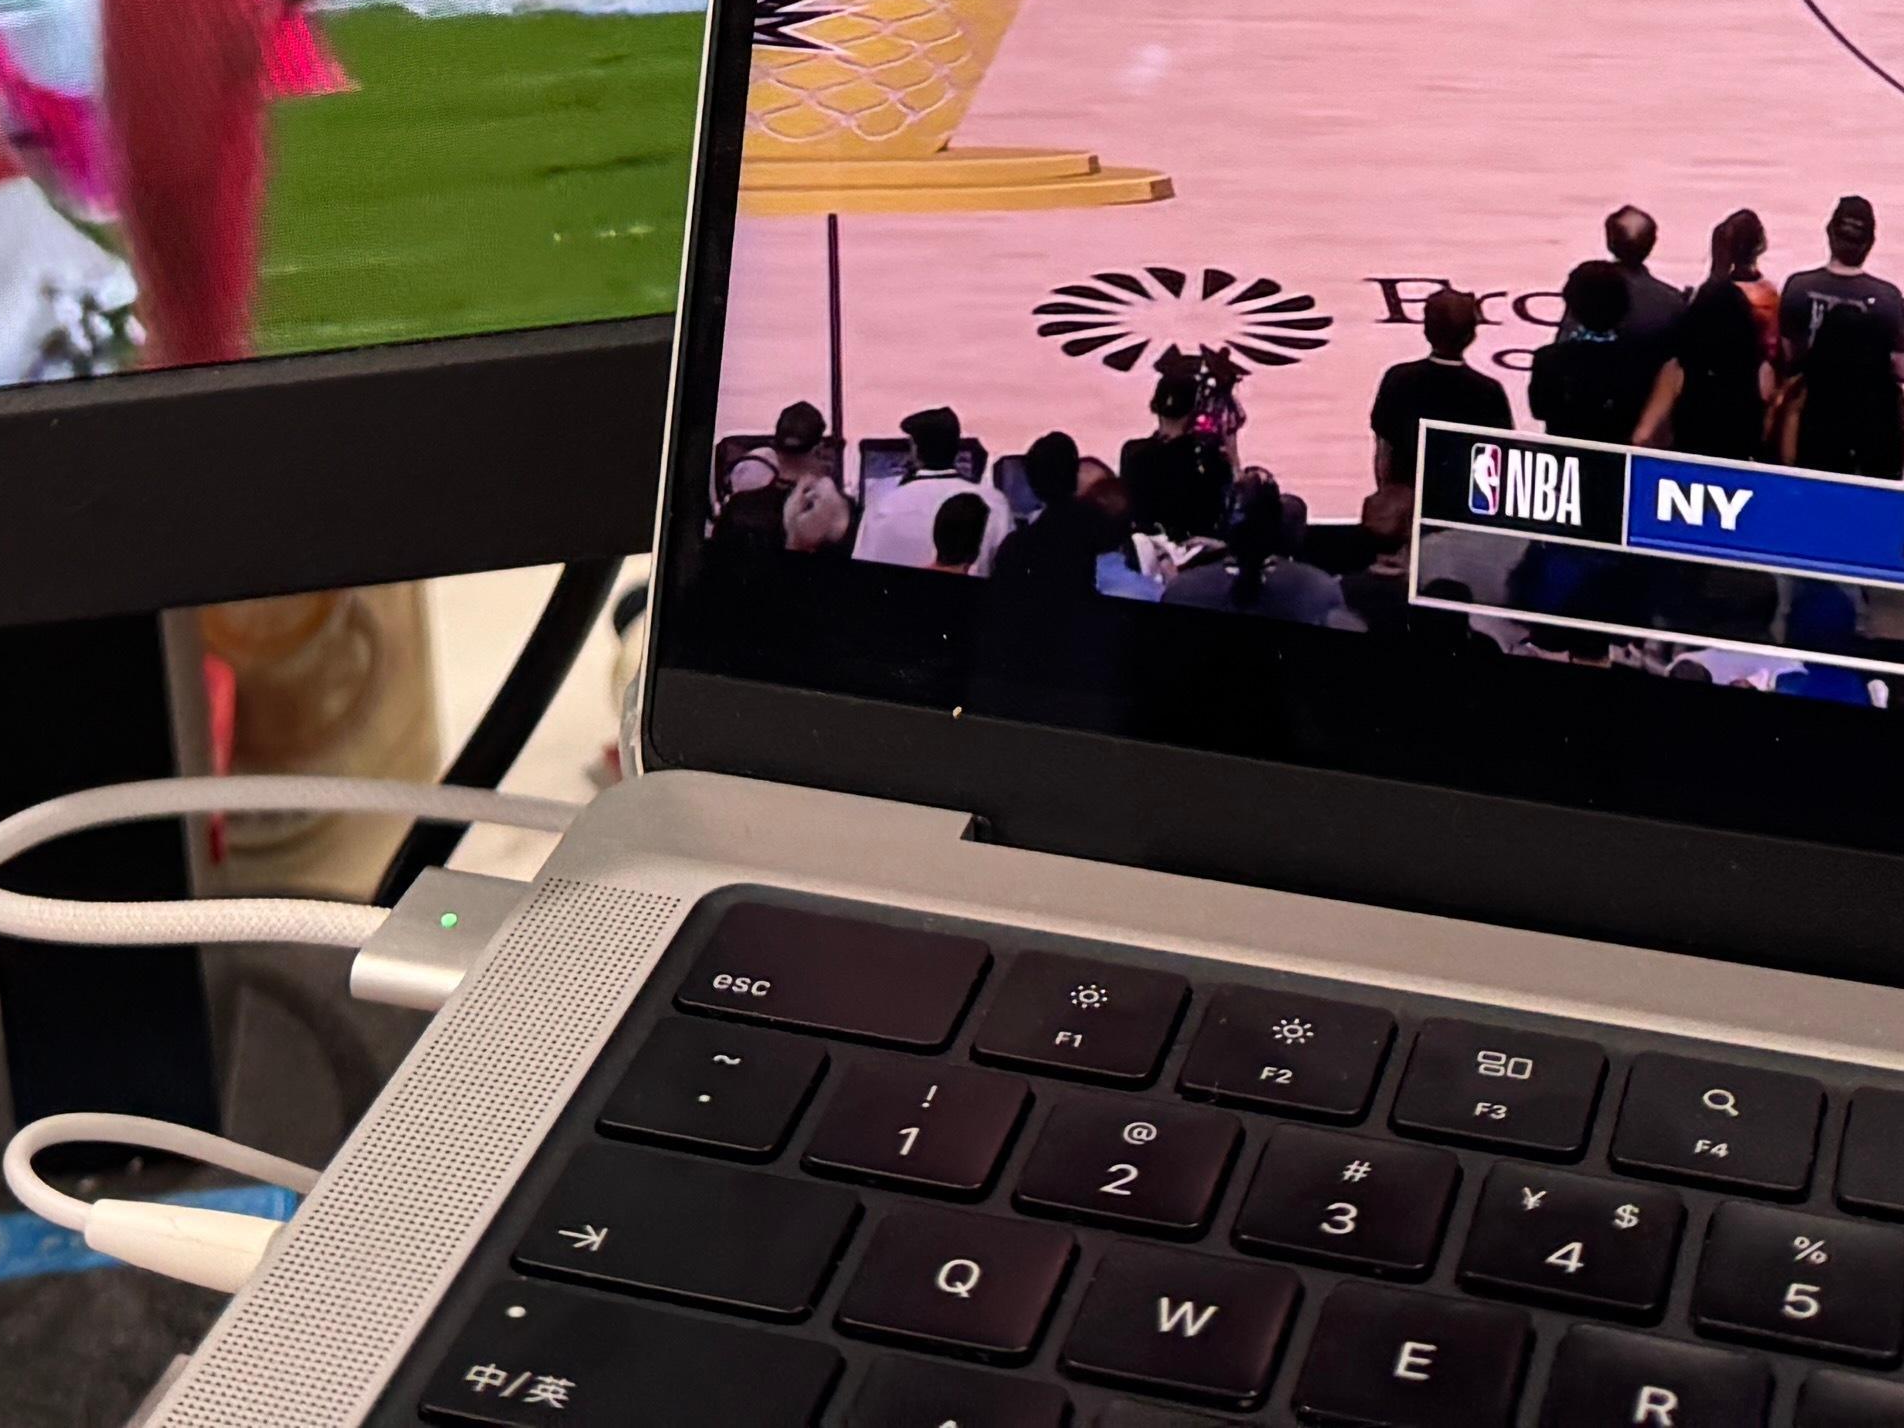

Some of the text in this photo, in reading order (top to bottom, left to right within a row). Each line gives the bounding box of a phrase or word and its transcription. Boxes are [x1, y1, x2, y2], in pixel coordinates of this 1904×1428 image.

[1504, 450, 1583, 528] NBA
[1655, 478, 1754, 531] NY
[712, 974, 771, 996] esc
[1054, 1031, 1084, 1048] F1
[1259, 1066, 1293, 1084] F2
[1474, 1102, 1508, 1120] F3
[899, 1127, 920, 1156] 1
[1122, 1121, 1158, 1145] @
[1694, 1139, 1730, 1158] F4
[1099, 1163, 1139, 1196] 2
[1342, 1160, 1373, 1182] #
[1320, 1202, 1358, 1235] 3
[1614, 1203, 1640, 1229] $
[1545, 1241, 1584, 1273] 4
[1793, 1236, 1828, 1264] %
[937, 1259, 981, 1298] Q
[1158, 1296, 1219, 1337] W
[1783, 1283, 1820, 1319] 5
[1394, 1341, 1437, 1380] E
[464, 1363, 577, 1410] 中/英
[1634, 1386, 1678, 1427] R
